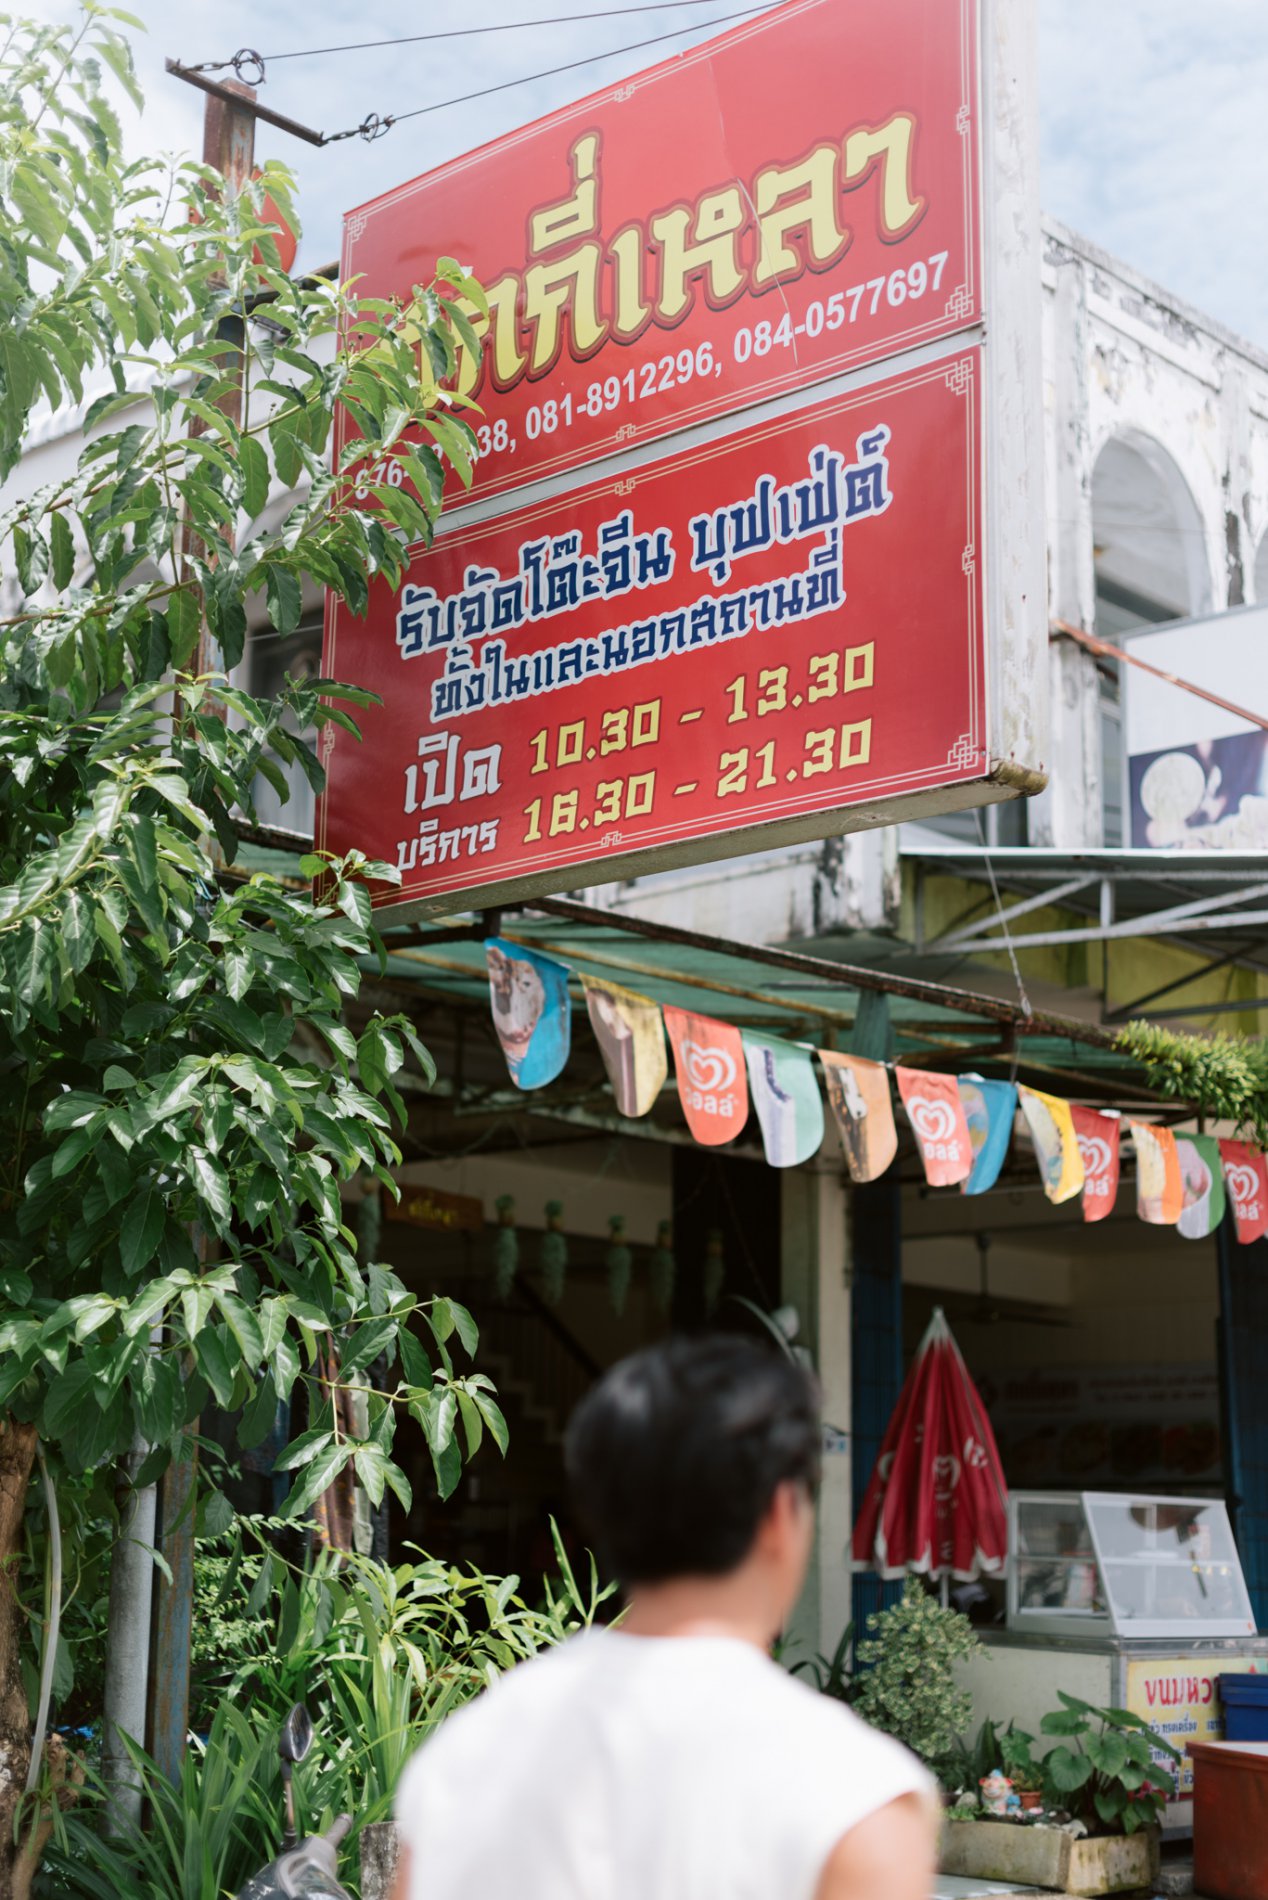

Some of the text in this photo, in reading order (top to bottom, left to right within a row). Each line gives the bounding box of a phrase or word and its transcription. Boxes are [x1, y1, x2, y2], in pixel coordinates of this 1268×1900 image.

[525, 340, 722, 440] 081-8912296,
[733, 250, 950, 364] 084-0577697
[398, 430, 890, 657] รับจัดโต๊ะจีน บุฟเฟ่ต์
[433, 526, 842, 718] ทั้งในและนอกสถานที่
[396, 818, 500, 872] บริการ
[521, 770, 656, 844] 16.30
[716, 717, 873, 798] 21.30
[402, 731, 503, 815] เปิด
[529, 699, 661, 775] 10.30
[725, 640, 875, 724] 13.30
